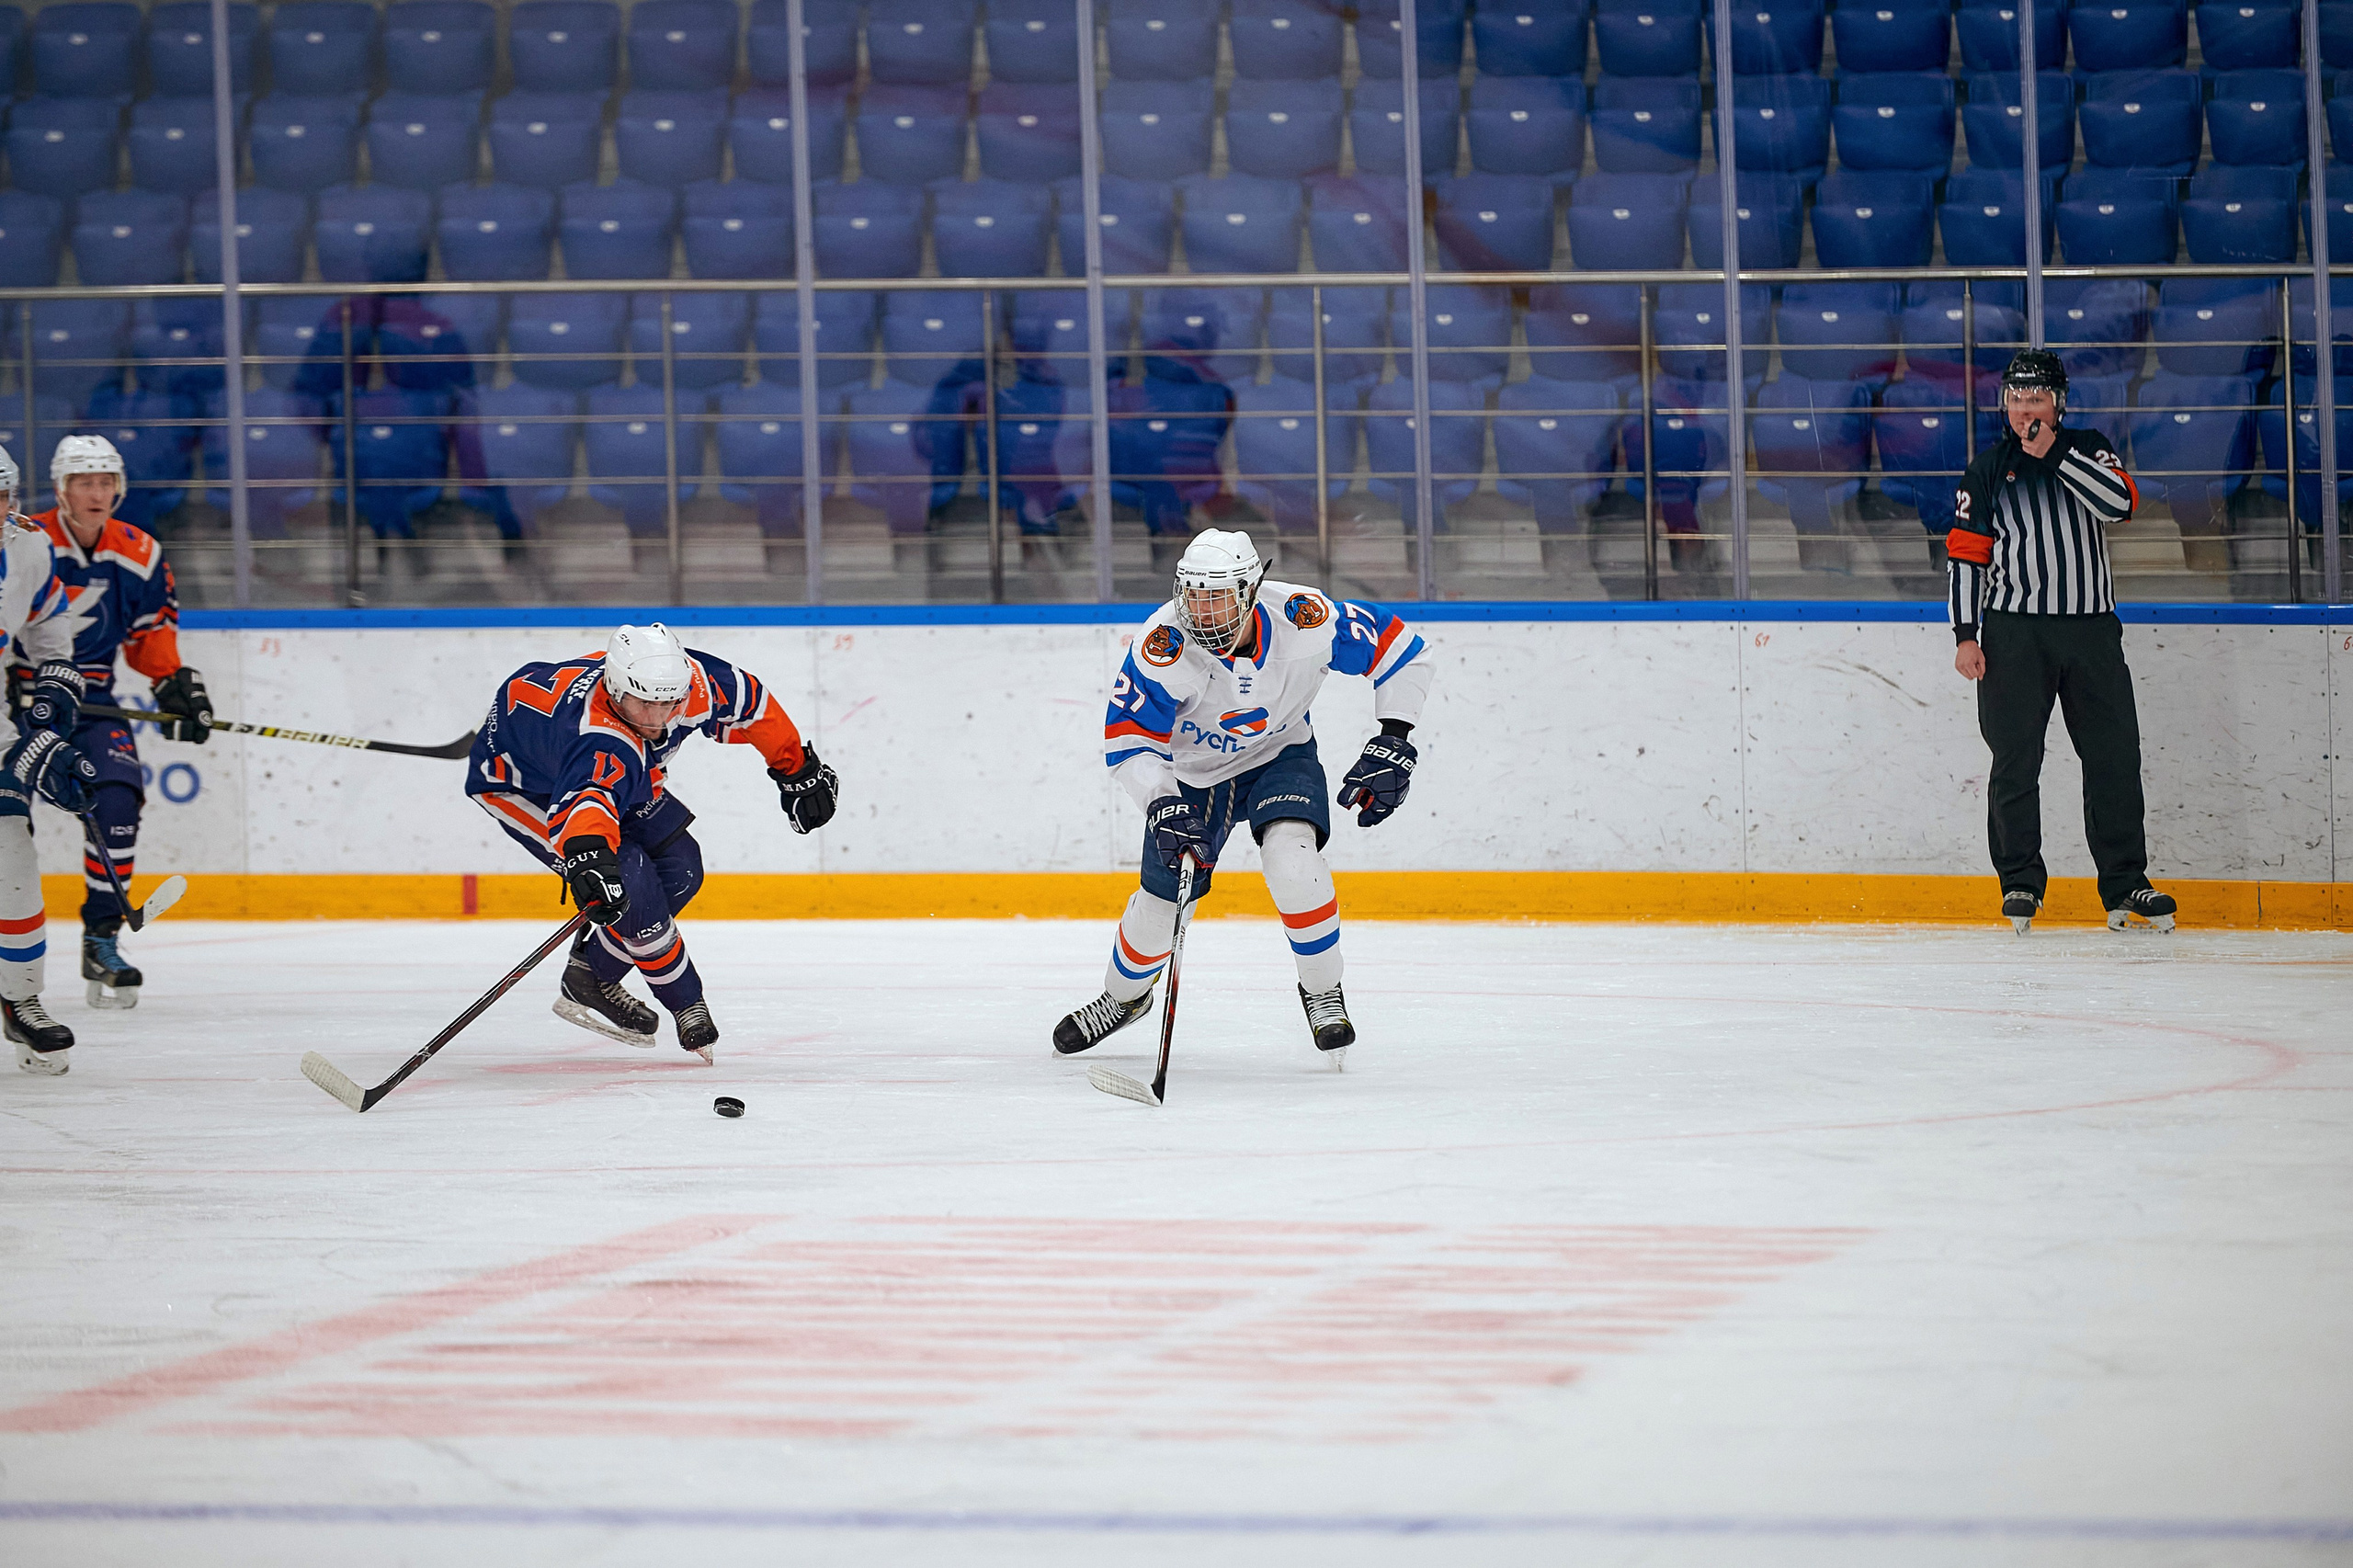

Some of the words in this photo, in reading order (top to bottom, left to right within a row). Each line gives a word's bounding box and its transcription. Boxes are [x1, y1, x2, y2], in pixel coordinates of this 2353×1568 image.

[1343, 601, 1380, 648] 27
[2344, 635, 2353, 651] 6
[1109, 671, 1146, 714] 27
[13, 730, 62, 782] WARRIOR
[587, 750, 626, 790] 17
[1256, 794, 1311, 811] BAUER
